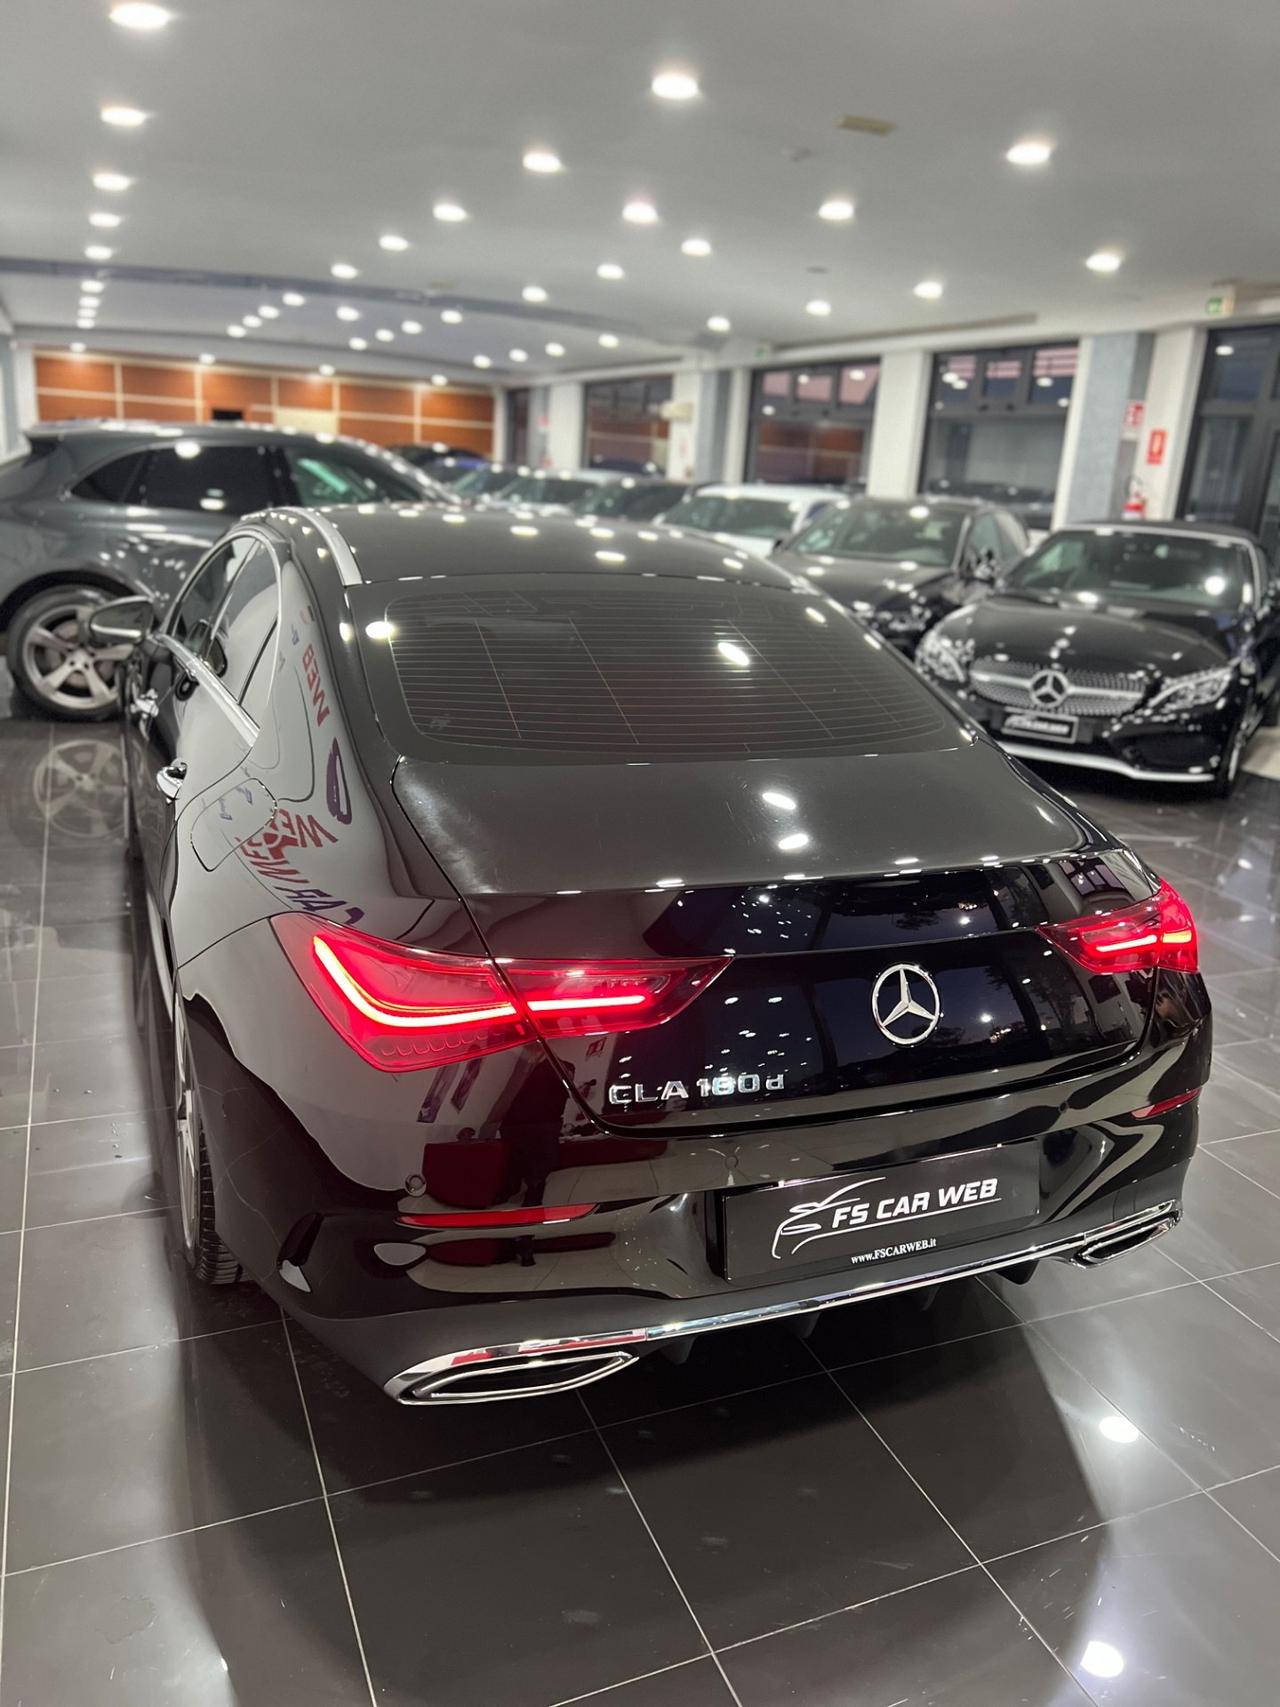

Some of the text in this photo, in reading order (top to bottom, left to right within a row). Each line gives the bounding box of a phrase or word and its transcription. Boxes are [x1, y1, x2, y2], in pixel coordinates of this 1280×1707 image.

[608, 1074, 785, 1105] CLA 180 d
[831, 1178, 998, 1229] FS CAR WEB
[851, 1238, 937, 1264] www.FSCARWEB.it
